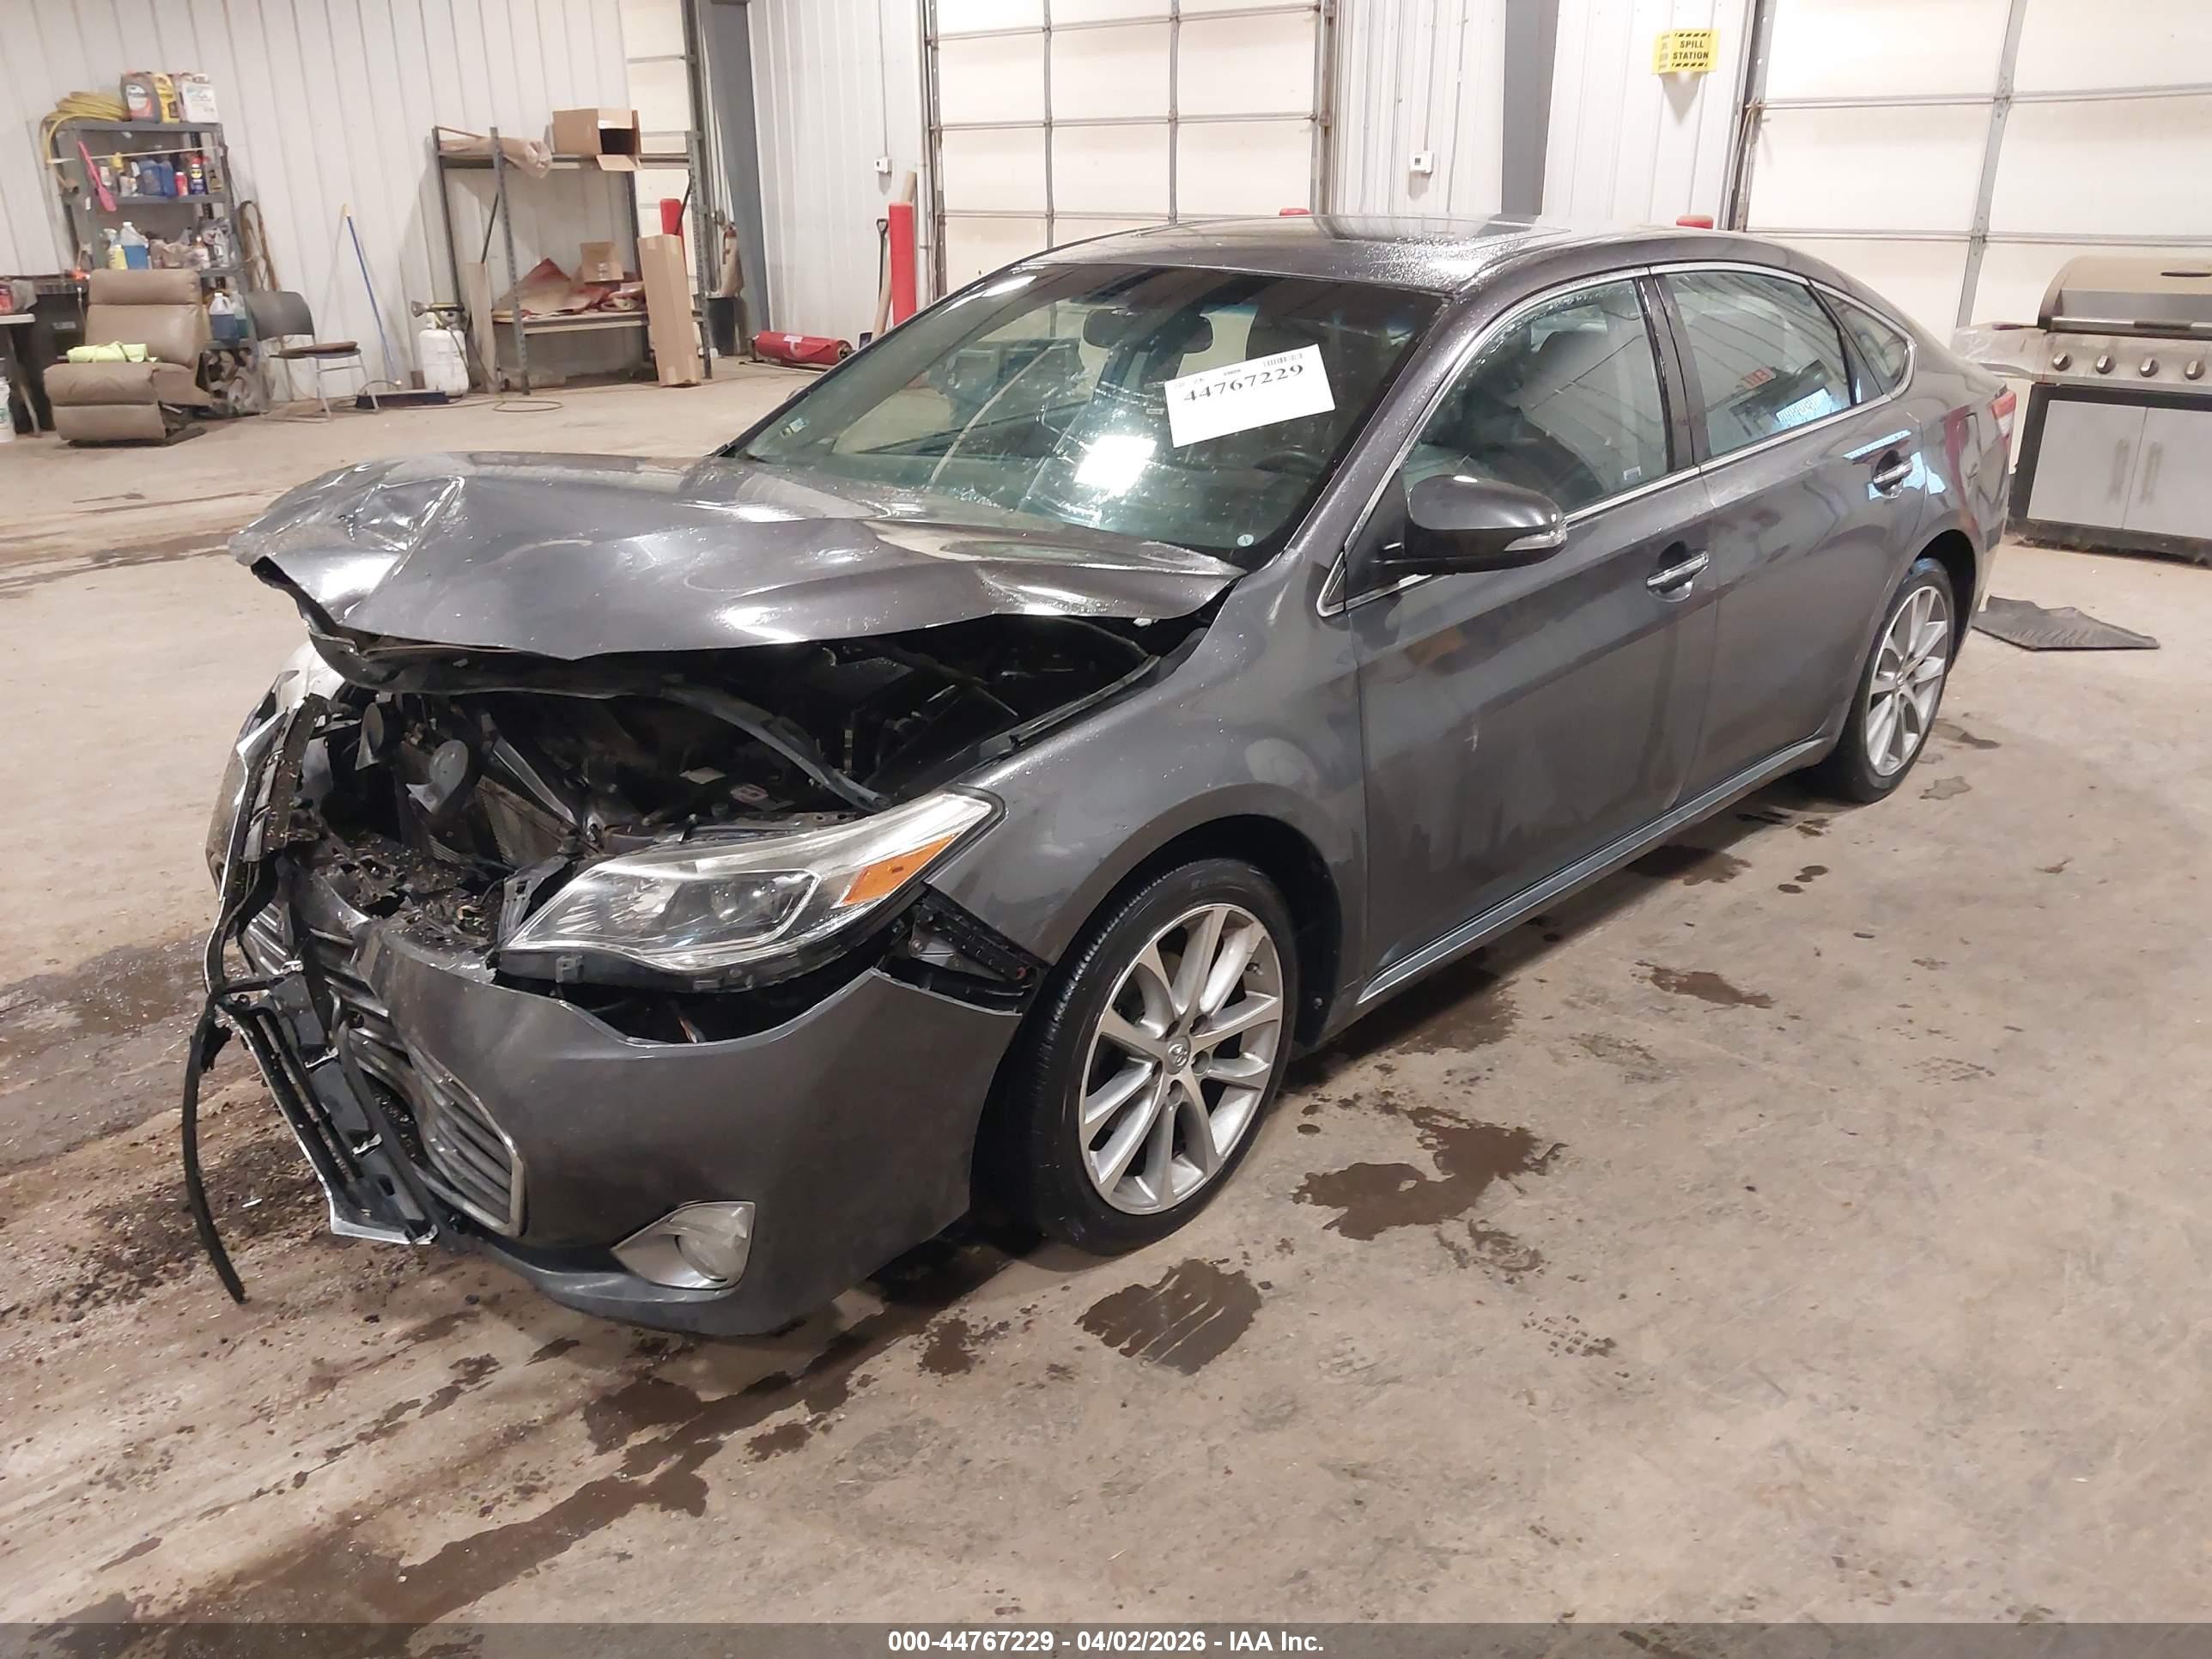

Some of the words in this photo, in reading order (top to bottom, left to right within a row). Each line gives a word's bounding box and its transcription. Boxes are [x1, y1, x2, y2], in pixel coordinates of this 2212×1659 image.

[1680, 40, 1705, 49] SPILL
[1672, 52, 1710, 60] STATION
[1183, 364, 1304, 401] 44767229
